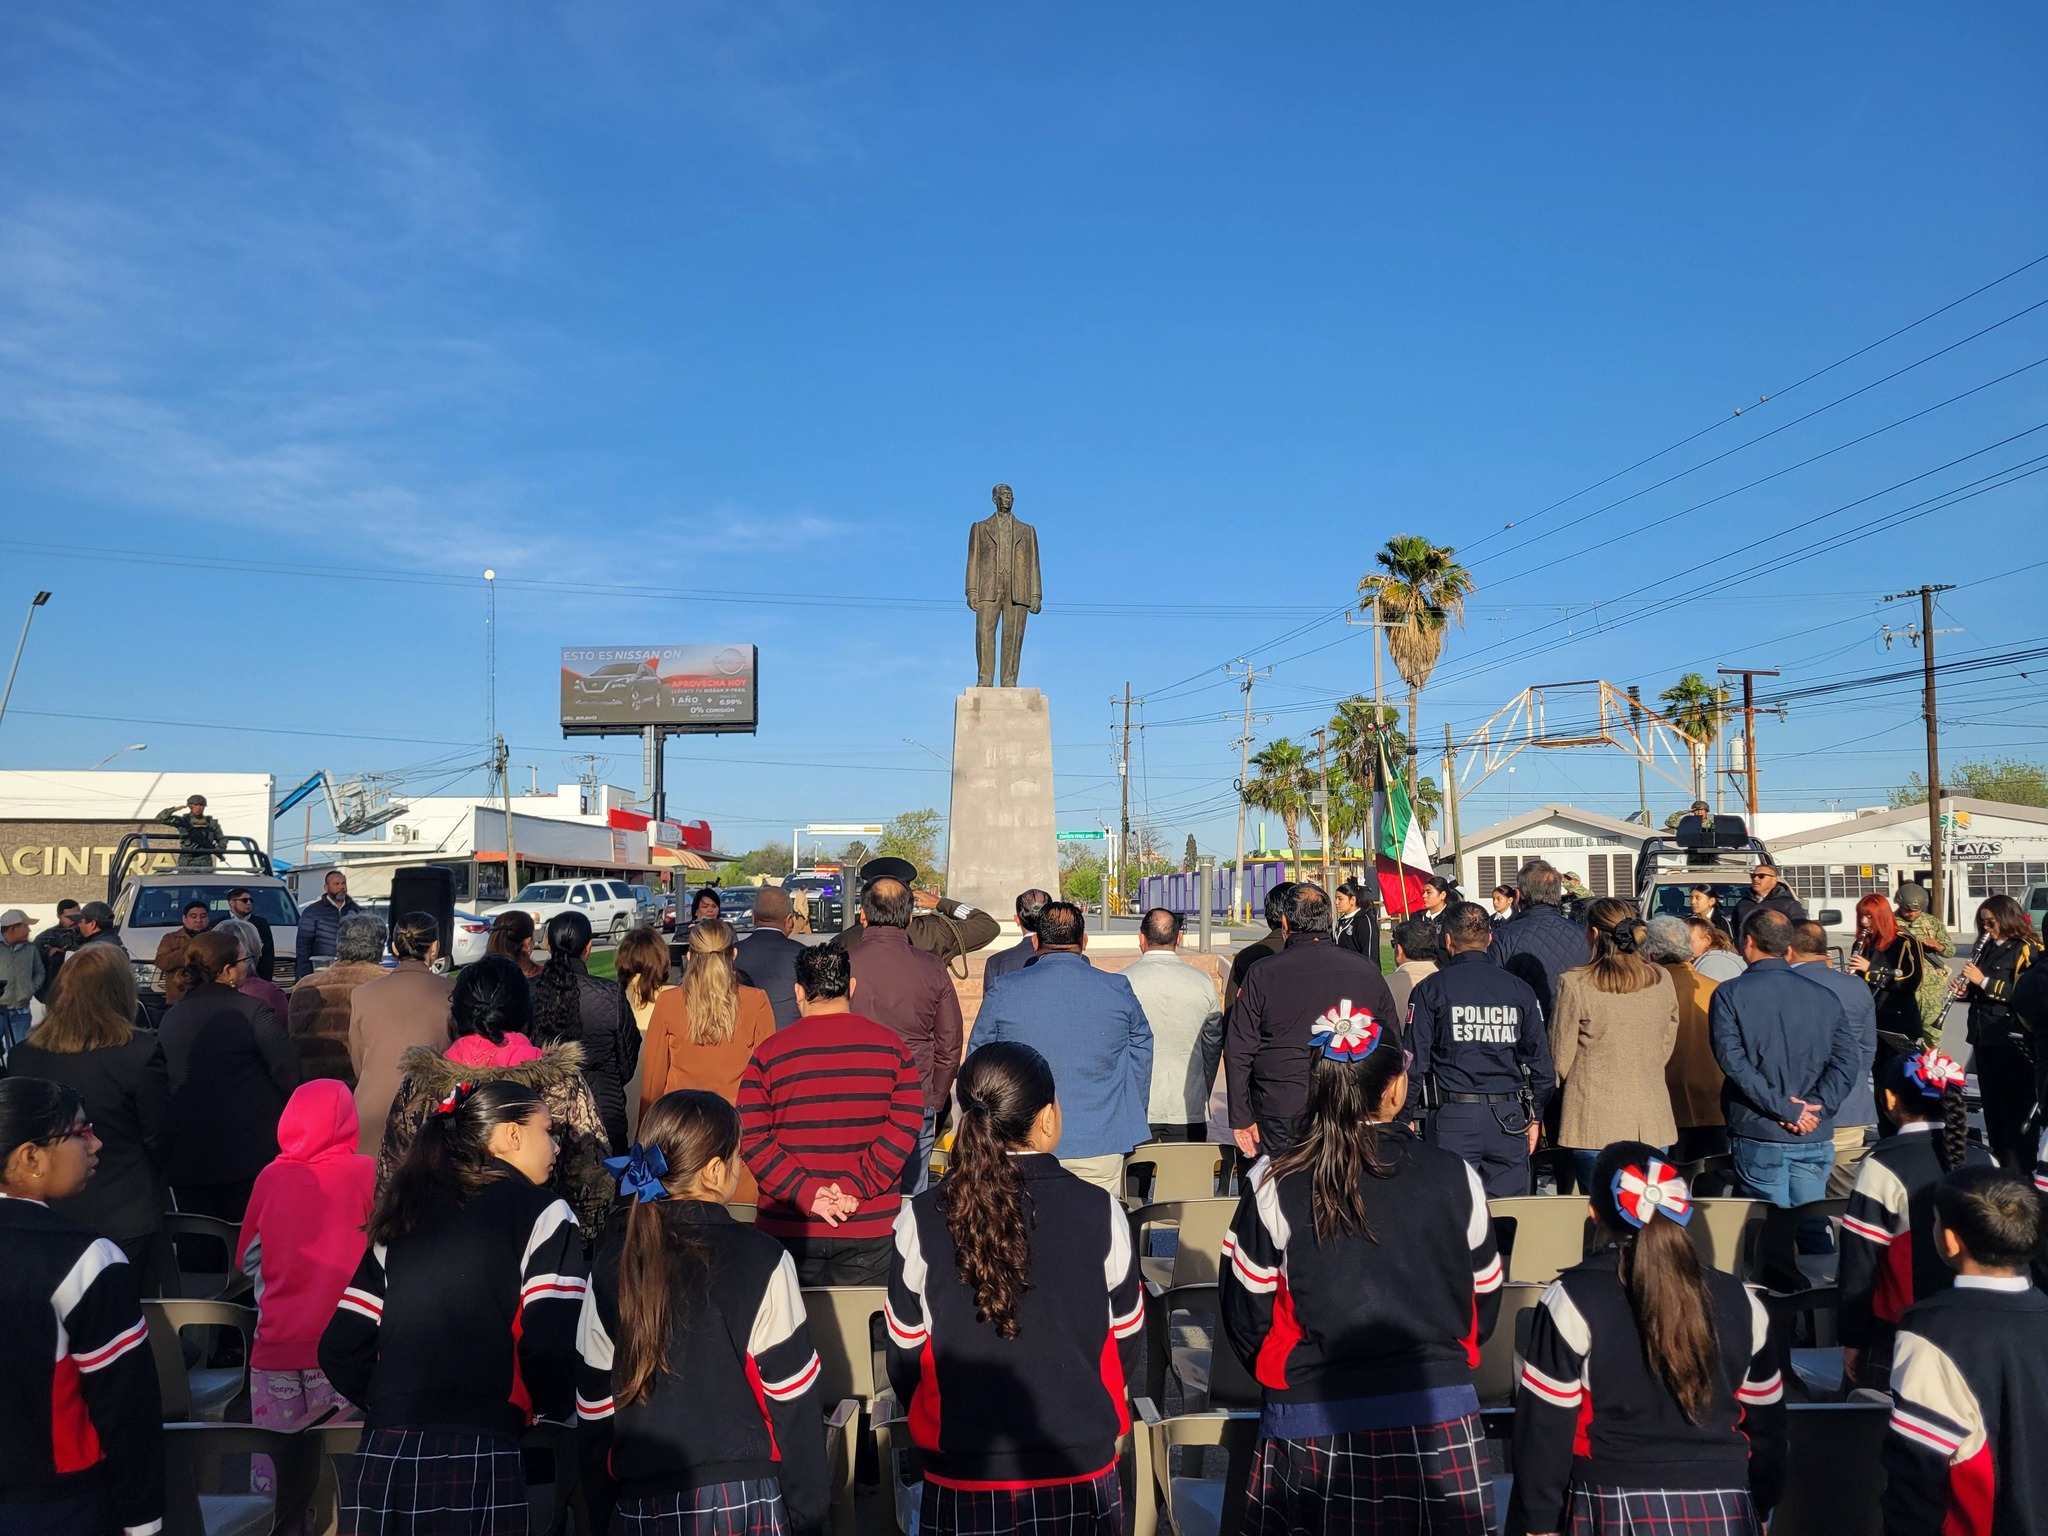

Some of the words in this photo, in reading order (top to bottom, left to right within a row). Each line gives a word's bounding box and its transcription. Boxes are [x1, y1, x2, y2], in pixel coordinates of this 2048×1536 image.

[563, 651, 595, 661] ESTO
[599, 651, 613, 660] ES
[614, 650, 660, 660] NISSAN
[663, 650, 682, 659] ON
[671, 679, 726, 688] APROVECHA
[728, 678, 748, 687] HOY
[678, 695, 699, 704] AÑO
[690, 706, 704, 714] 0%
[1505, 837, 1561, 849] RESTAURANT
[1909, 843, 1932, 856] LA
[1451, 1005, 1518, 1025] POLICÍA
[1452, 1024, 1518, 1043] ESTATAL
